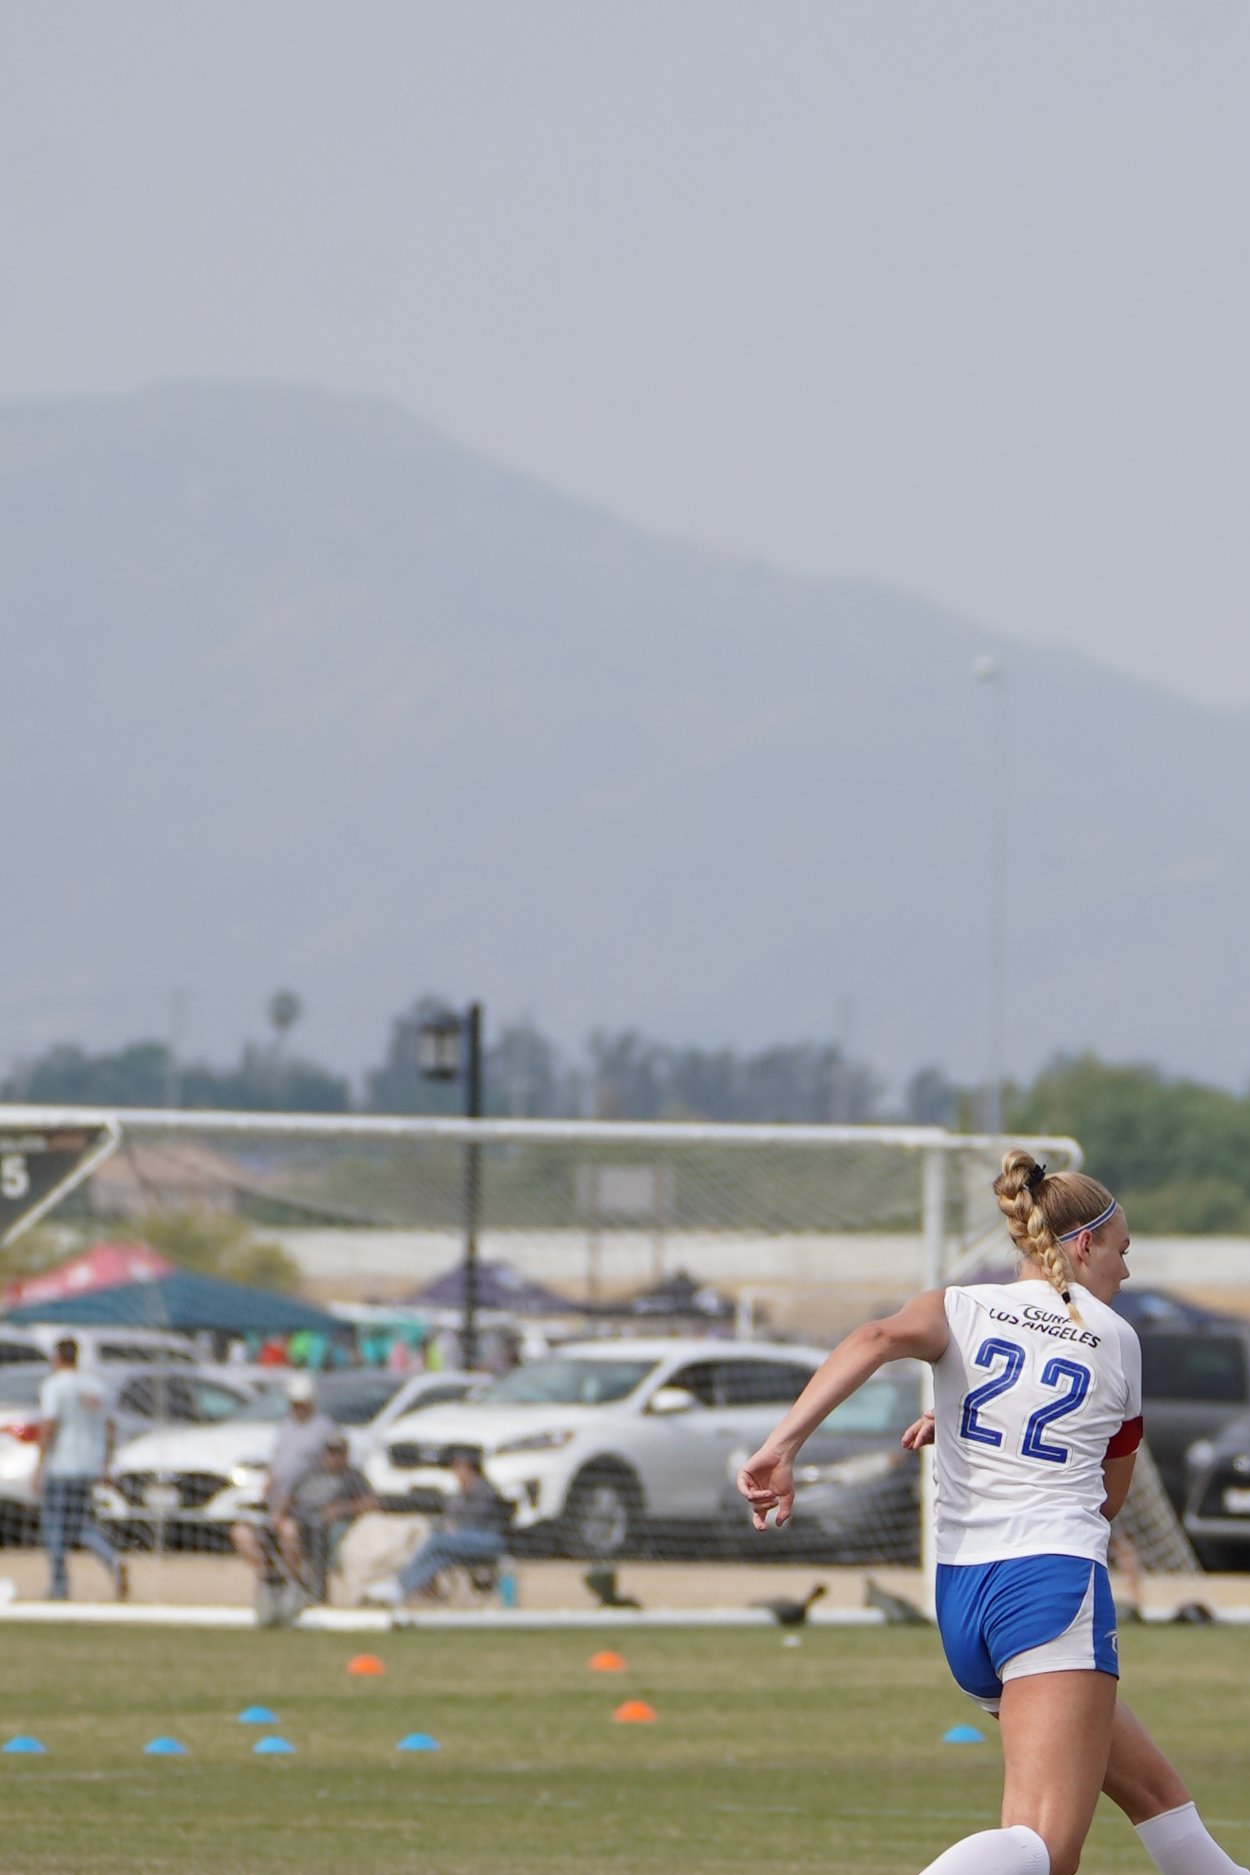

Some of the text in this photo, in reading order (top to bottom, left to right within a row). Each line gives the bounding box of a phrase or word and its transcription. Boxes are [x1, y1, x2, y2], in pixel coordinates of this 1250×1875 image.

[2, 1154, 29, 1199] 5
[989, 1308, 1101, 1348] LOS ANGELES
[960, 1337, 1091, 1464] 22
